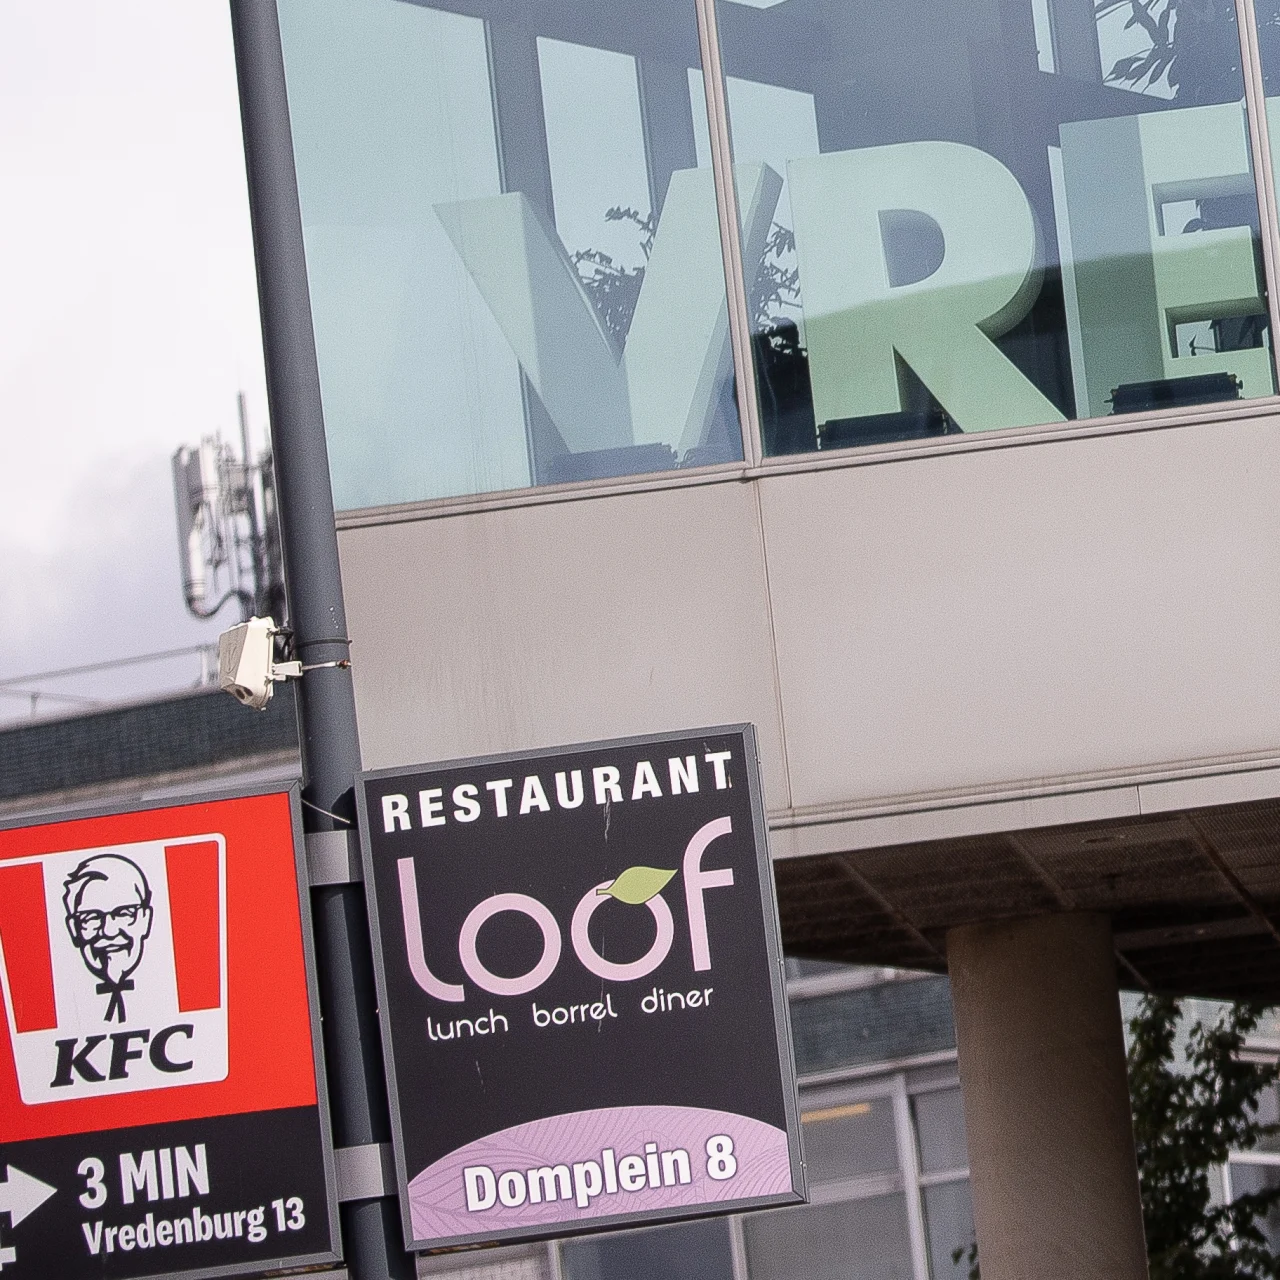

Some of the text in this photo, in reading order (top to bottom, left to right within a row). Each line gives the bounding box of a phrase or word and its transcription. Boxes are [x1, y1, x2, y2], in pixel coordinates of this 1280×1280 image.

[381, 751, 732, 833] RESTAURANT
[397, 815, 735, 1002] loof
[427, 987, 714, 1041] lunch borrel diner
[50, 1022, 196, 1089] KFC
[77, 1143, 211, 1210] 3 MIN
[463, 1133, 738, 1212] Domplein 8
[82, 1196, 306, 1256] Vredenburg 13
